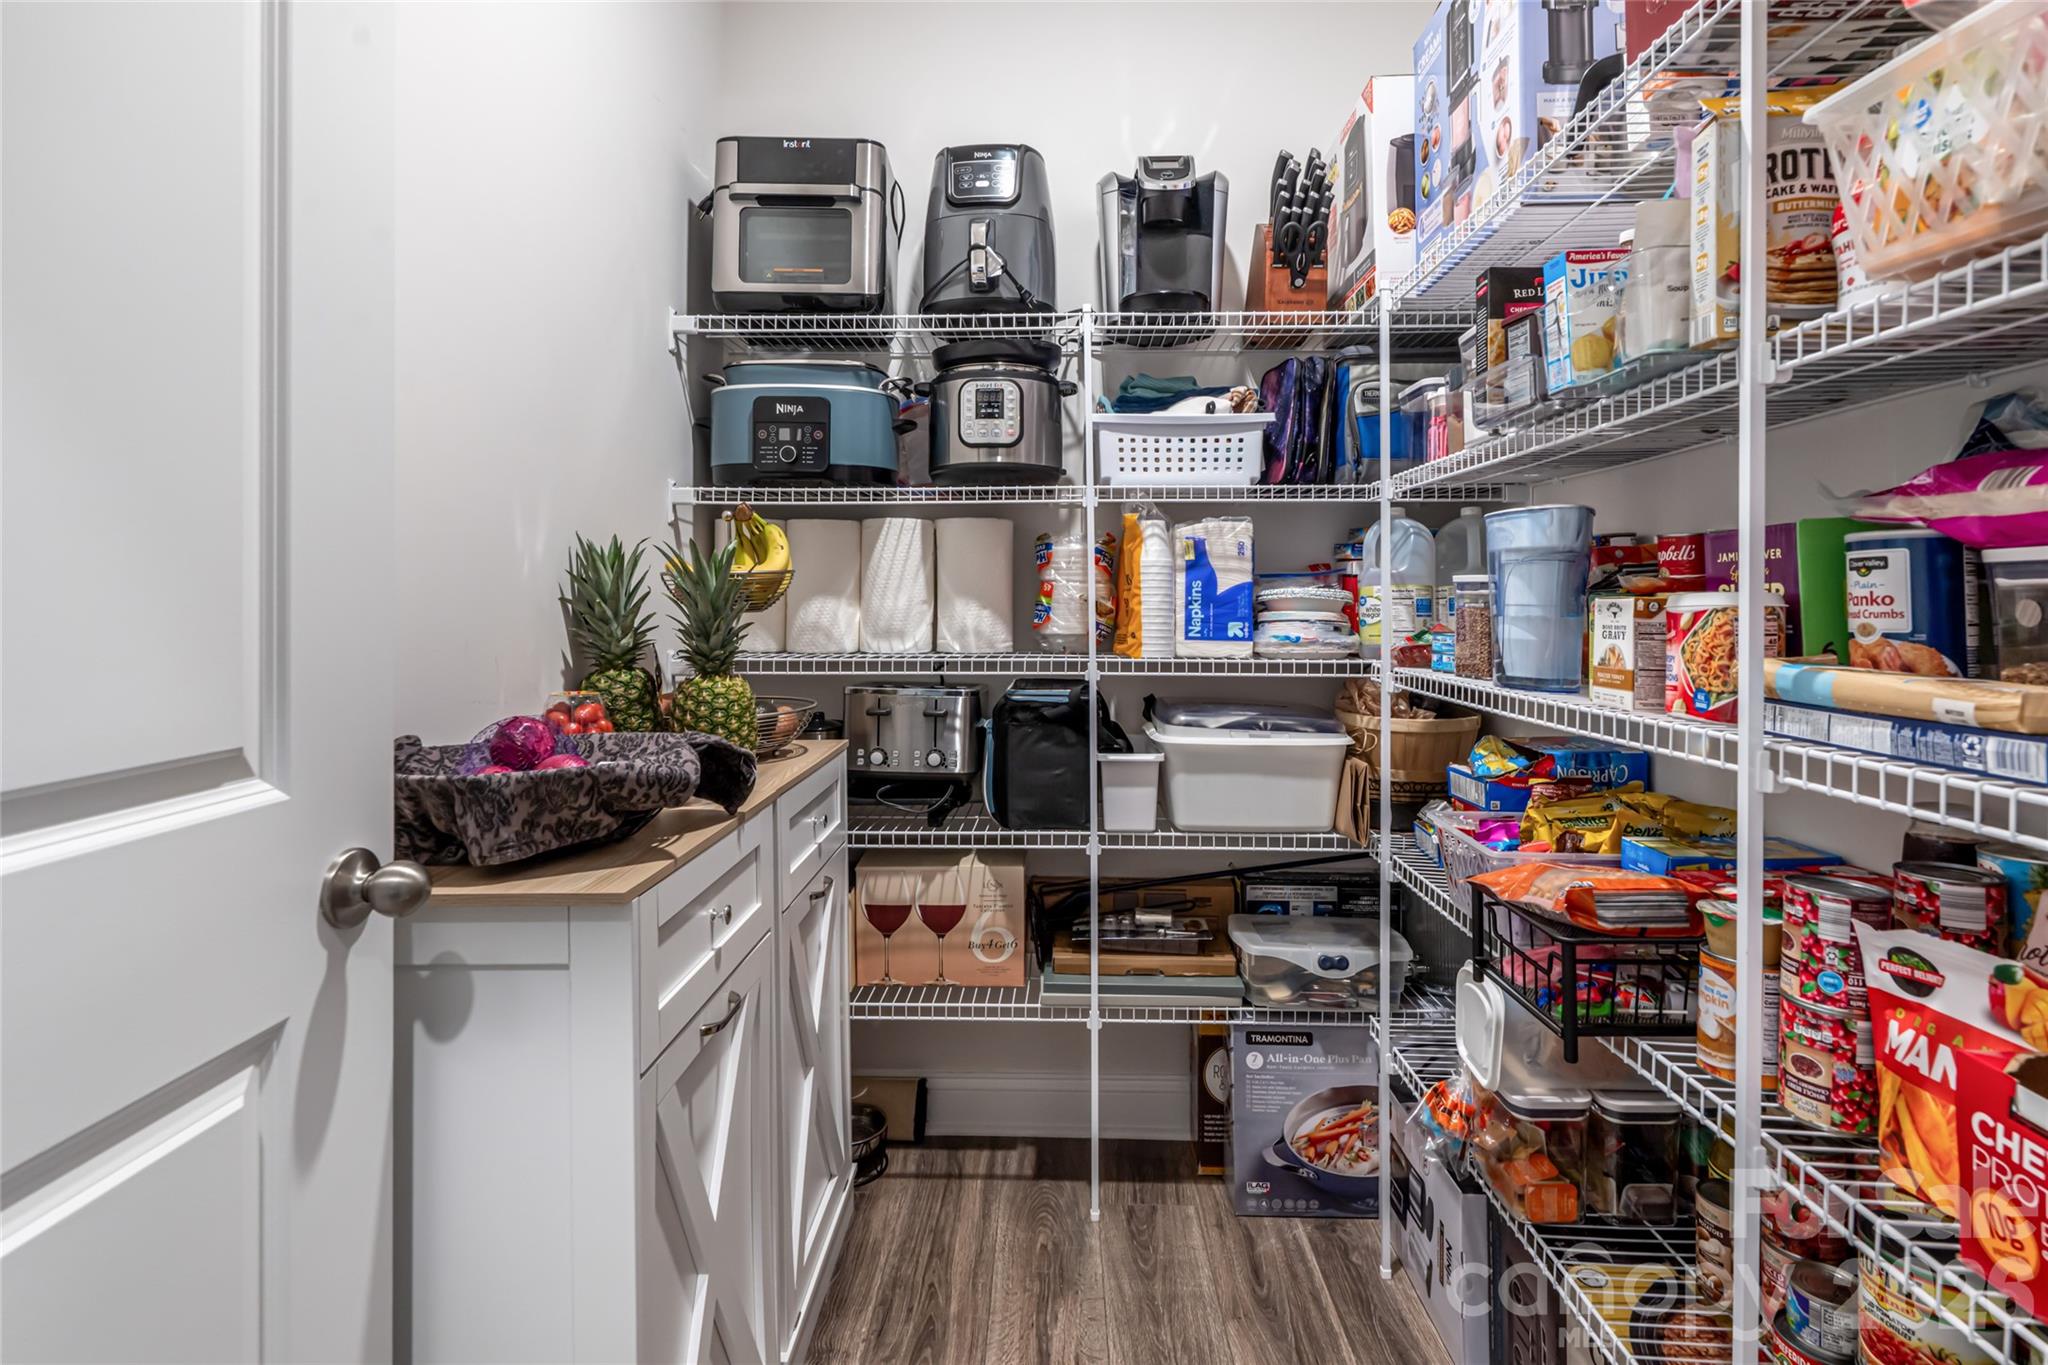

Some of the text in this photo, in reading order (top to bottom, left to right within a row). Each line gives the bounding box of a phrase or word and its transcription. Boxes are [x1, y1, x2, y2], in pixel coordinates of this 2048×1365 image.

[1767, 147, 1834, 185] ROTE
[1767, 184, 1795, 199] CAKE
[1799, 183, 1807, 193] &
[1777, 201, 1836, 212] BUTTERMIL
[1569, 251, 1606, 261] America's
[1513, 288, 1535, 299] RED
[1667, 285, 1690, 293] Soup
[776, 403, 804, 416] NINJA
[1717, 551, 1739, 563] JAMI
[1847, 590, 1895, 607] Panko
[1188, 579, 1204, 638] Napkins
[1862, 608, 1905, 619] Crumbs
[1602, 630, 1627, 641] GRAVY
[1880, 961, 1912, 976] PERFECT
[1250, 1034, 1309, 1044] TRAMONTINA
[1251, 1053, 1372, 1065] 7 All-in-One Plus Pan
[1884, 1018, 1958, 1092] MAN
[1970, 1111, 2048, 1181] CHE
